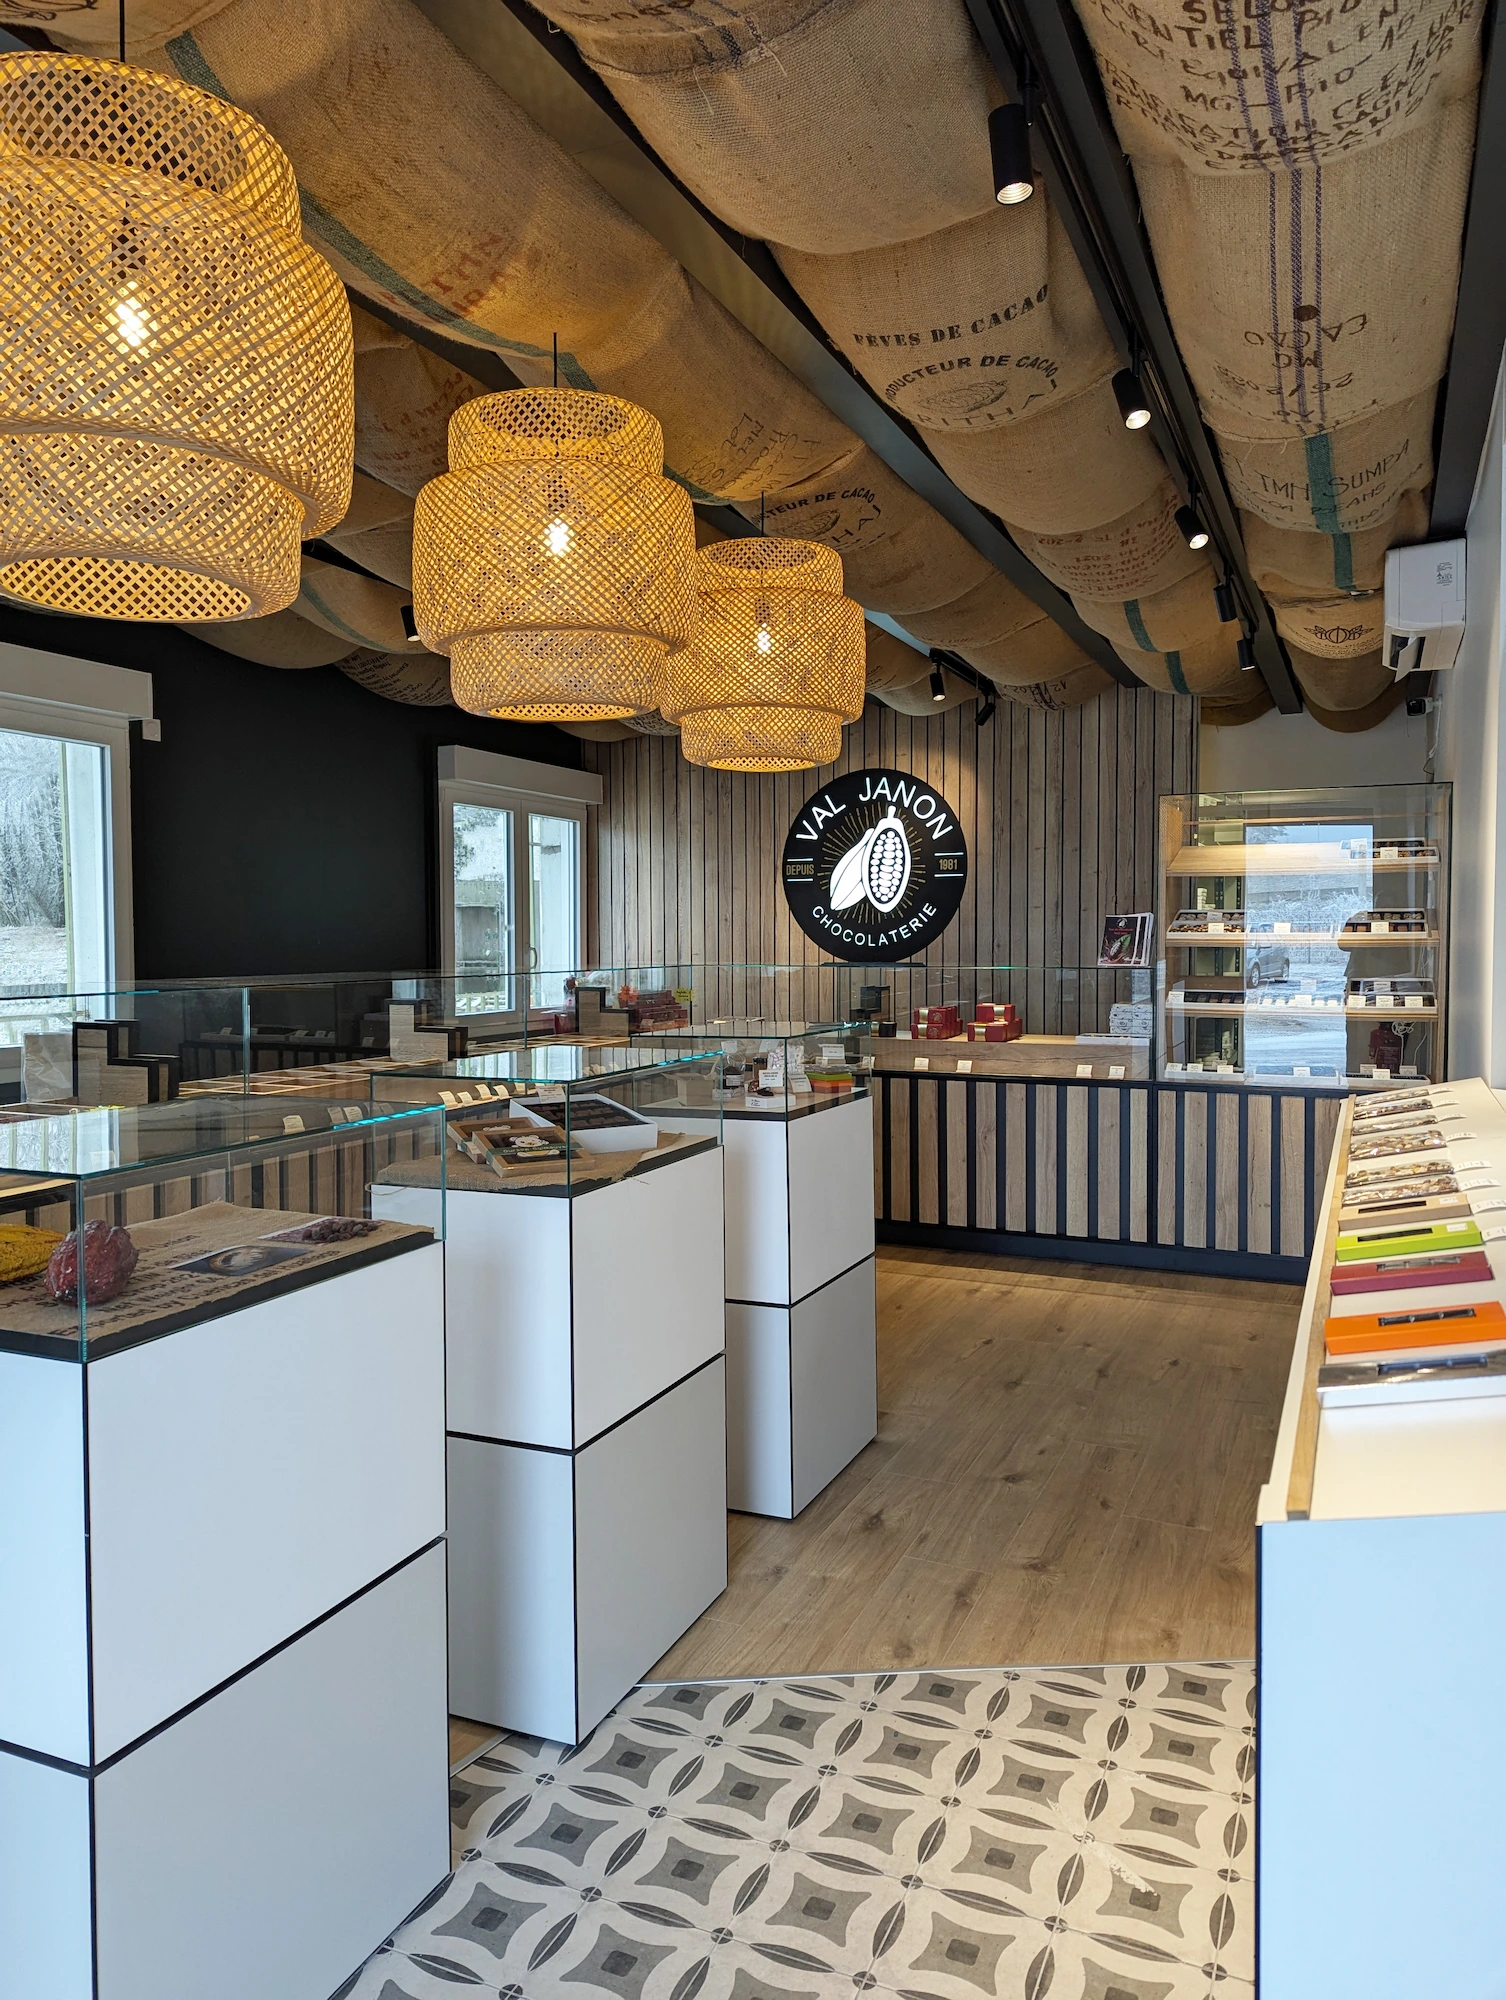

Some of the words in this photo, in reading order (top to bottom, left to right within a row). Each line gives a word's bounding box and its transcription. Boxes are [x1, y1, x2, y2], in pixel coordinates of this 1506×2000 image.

[930, 324, 962, 344] DE
[970, 284, 1049, 336] CACAO
[980, 355, 1012, 367] DE
[1015, 355, 1060, 380] CACAO
[815, 491, 837, 503] DE
[841, 487, 875, 503] CACAO
[796, 795, 846, 841] VAL
[859, 777, 953, 841] JANON
[786, 864, 815, 875] DEPUIS
[939, 858, 958, 871] 1981
[812, 902, 937, 946] CHOCOLATERIE
